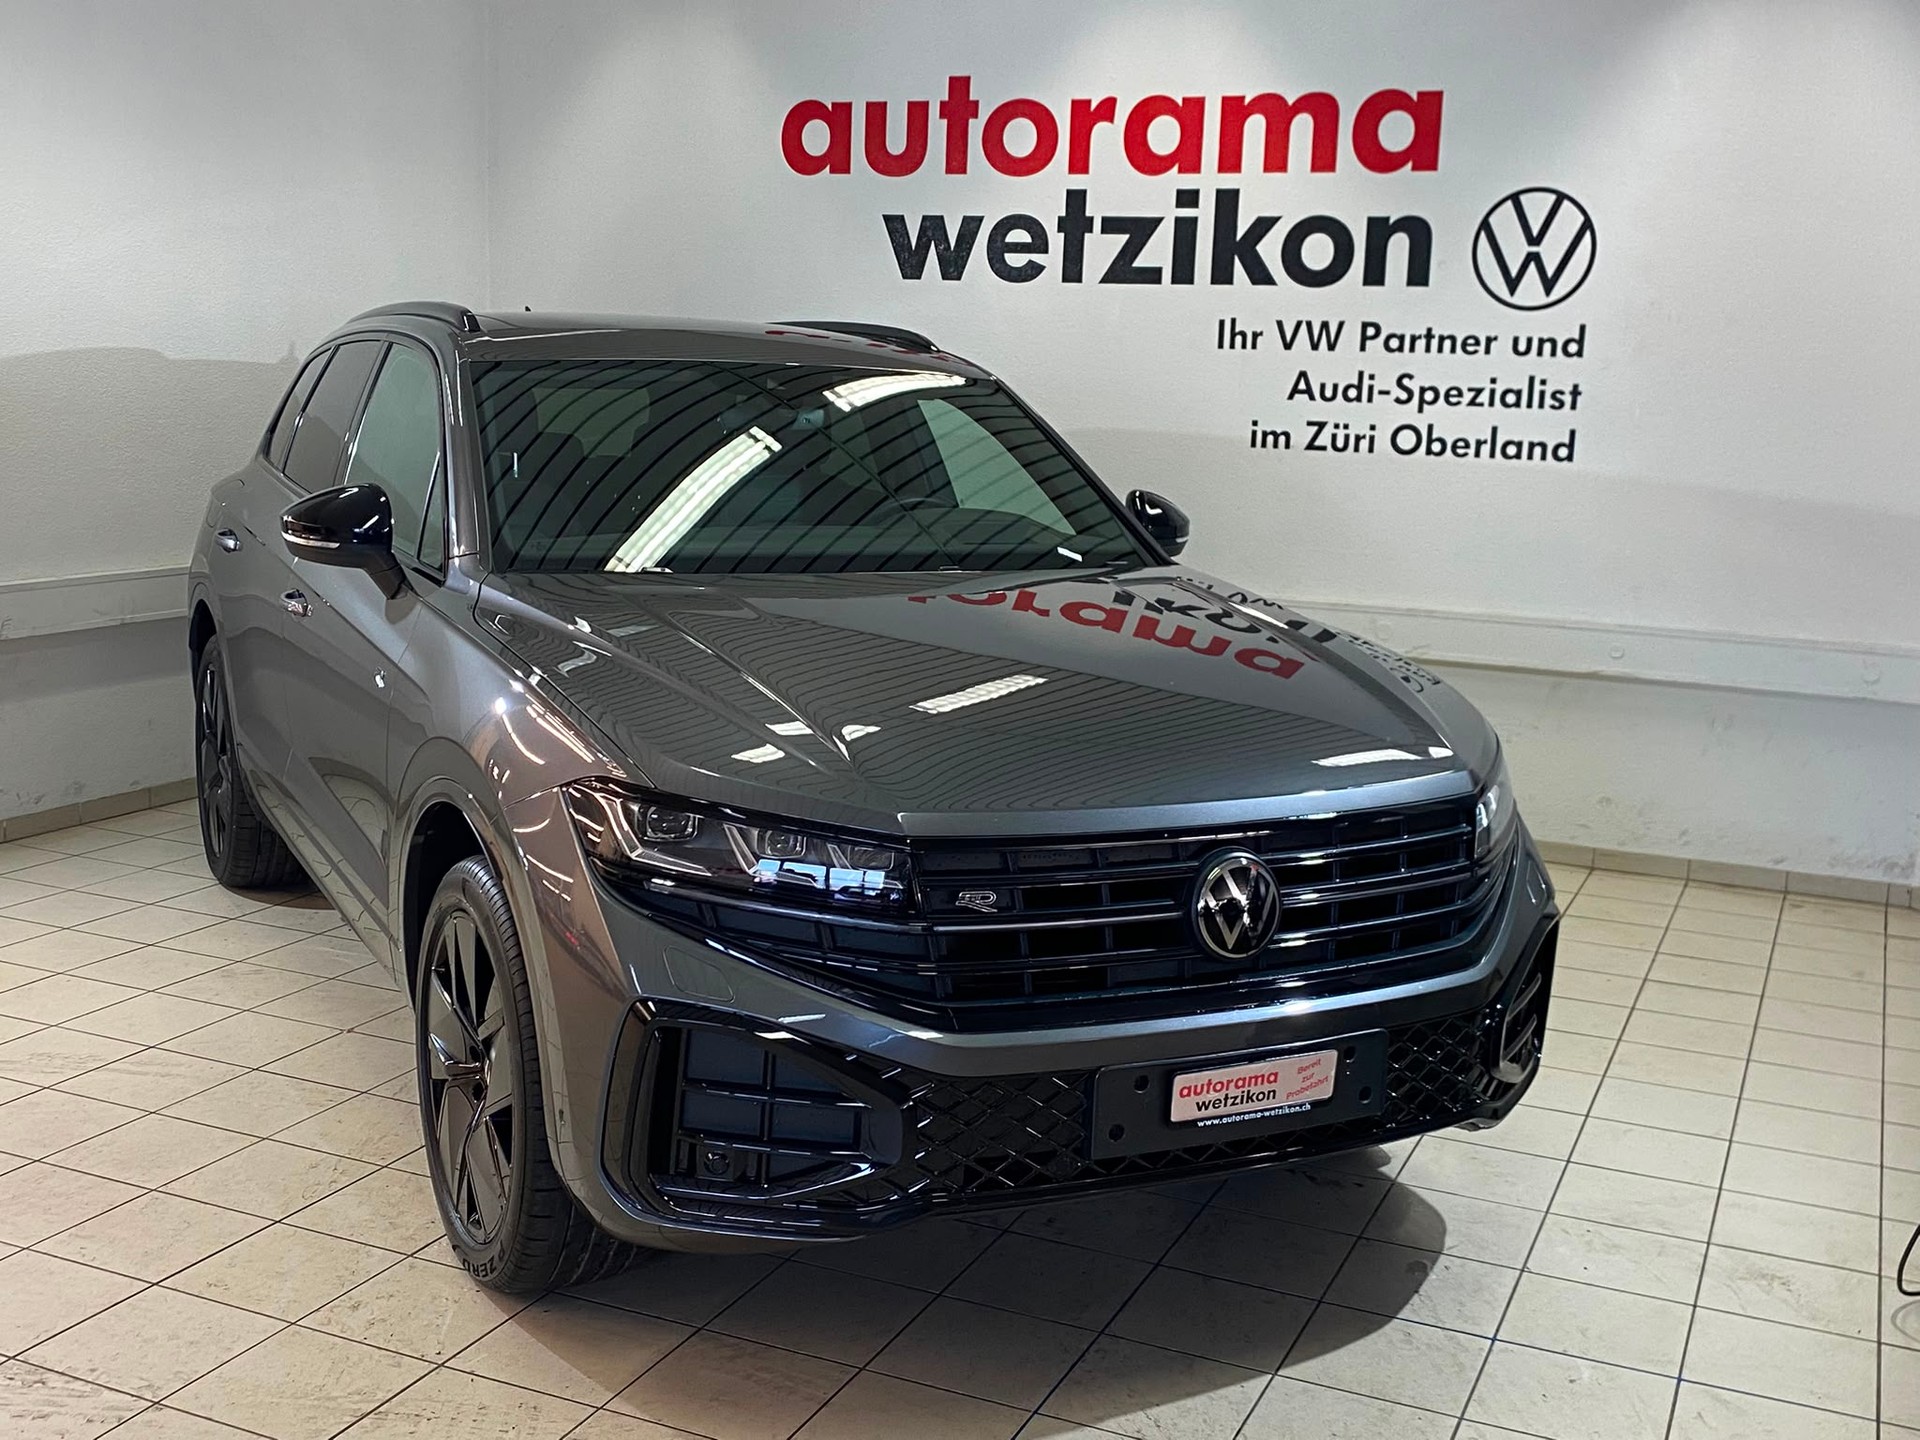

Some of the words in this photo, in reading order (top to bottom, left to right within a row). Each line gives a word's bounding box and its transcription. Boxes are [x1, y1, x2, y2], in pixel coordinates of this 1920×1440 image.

[781, 76, 1444, 177] autorama
[882, 188, 1433, 288] wetzikon
[1217, 317, 1264, 350] Ihr
[1275, 319, 1346, 352] VW
[1359, 321, 1498, 356] Partner
[1512, 323, 1587, 358] und
[1286, 370, 1582, 414] Audi-Spezialist
[1250, 419, 1291, 450] im
[1303, 420, 1376, 454] Züri
[1390, 423, 1576, 463] Oberland
[1297, 1058, 1322, 1075] Bereit
[1301, 1072, 1315, 1084] zur
[1179, 1071, 1279, 1098] autorama
[1286, 1075, 1329, 1100] Probefahrt
[1195, 1088, 1277, 1112] wetzikon
[1197, 1102, 1312, 1127] www.autorama-wetzikon.ch
